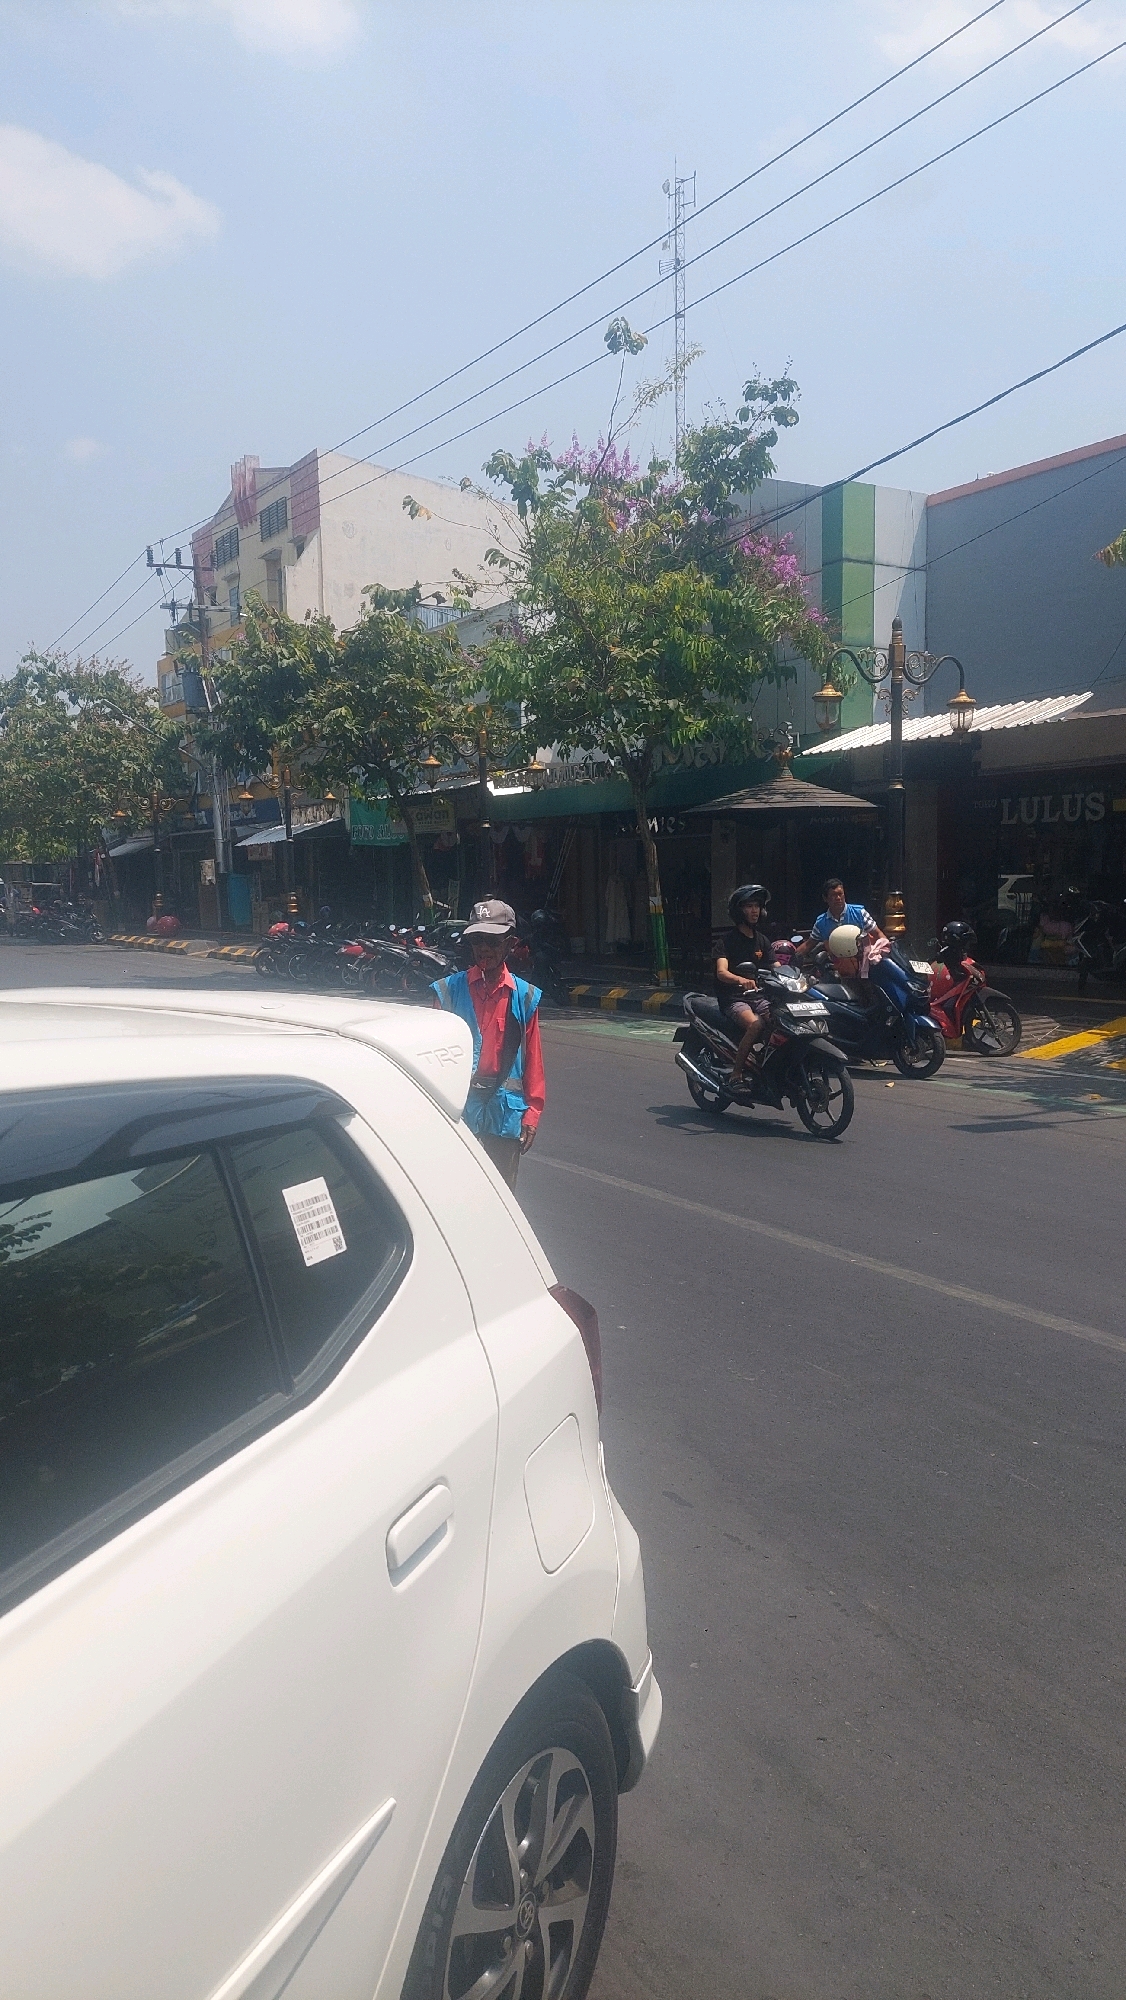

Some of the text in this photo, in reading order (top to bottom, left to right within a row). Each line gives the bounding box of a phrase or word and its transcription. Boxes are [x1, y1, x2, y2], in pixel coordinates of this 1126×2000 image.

[1000, 792, 1105, 825] LULUS
[477, 905, 491, 918] LA
[416, 1044, 465, 1068] TRD
